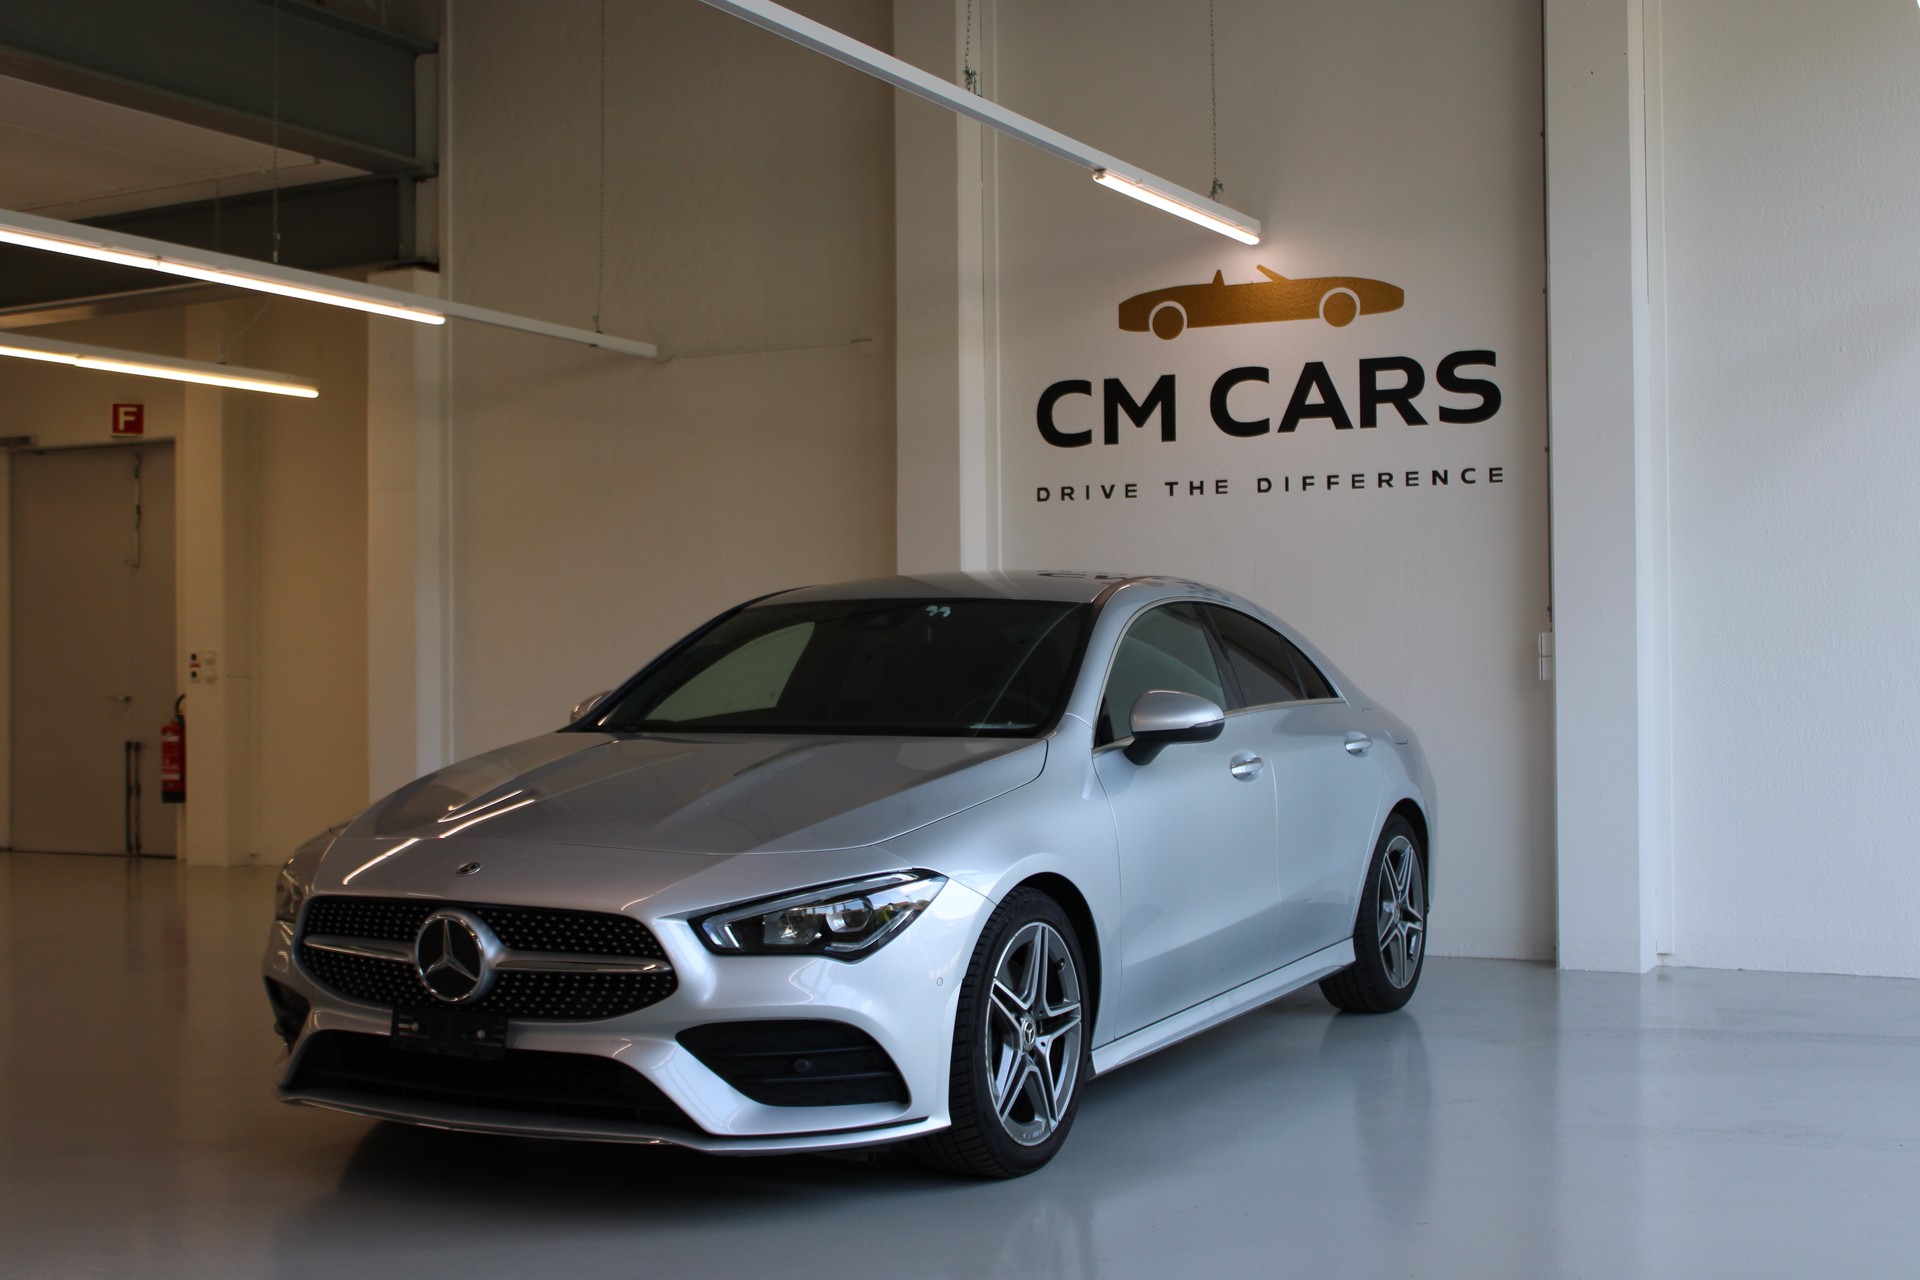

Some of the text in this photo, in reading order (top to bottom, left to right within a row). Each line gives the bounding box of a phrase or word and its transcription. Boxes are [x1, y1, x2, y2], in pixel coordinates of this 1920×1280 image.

[1036, 349, 1502, 449] CM CARS
[118, 407, 138, 431] F
[1036, 466, 1504, 503] DRIVE THE DIFFERENCE
